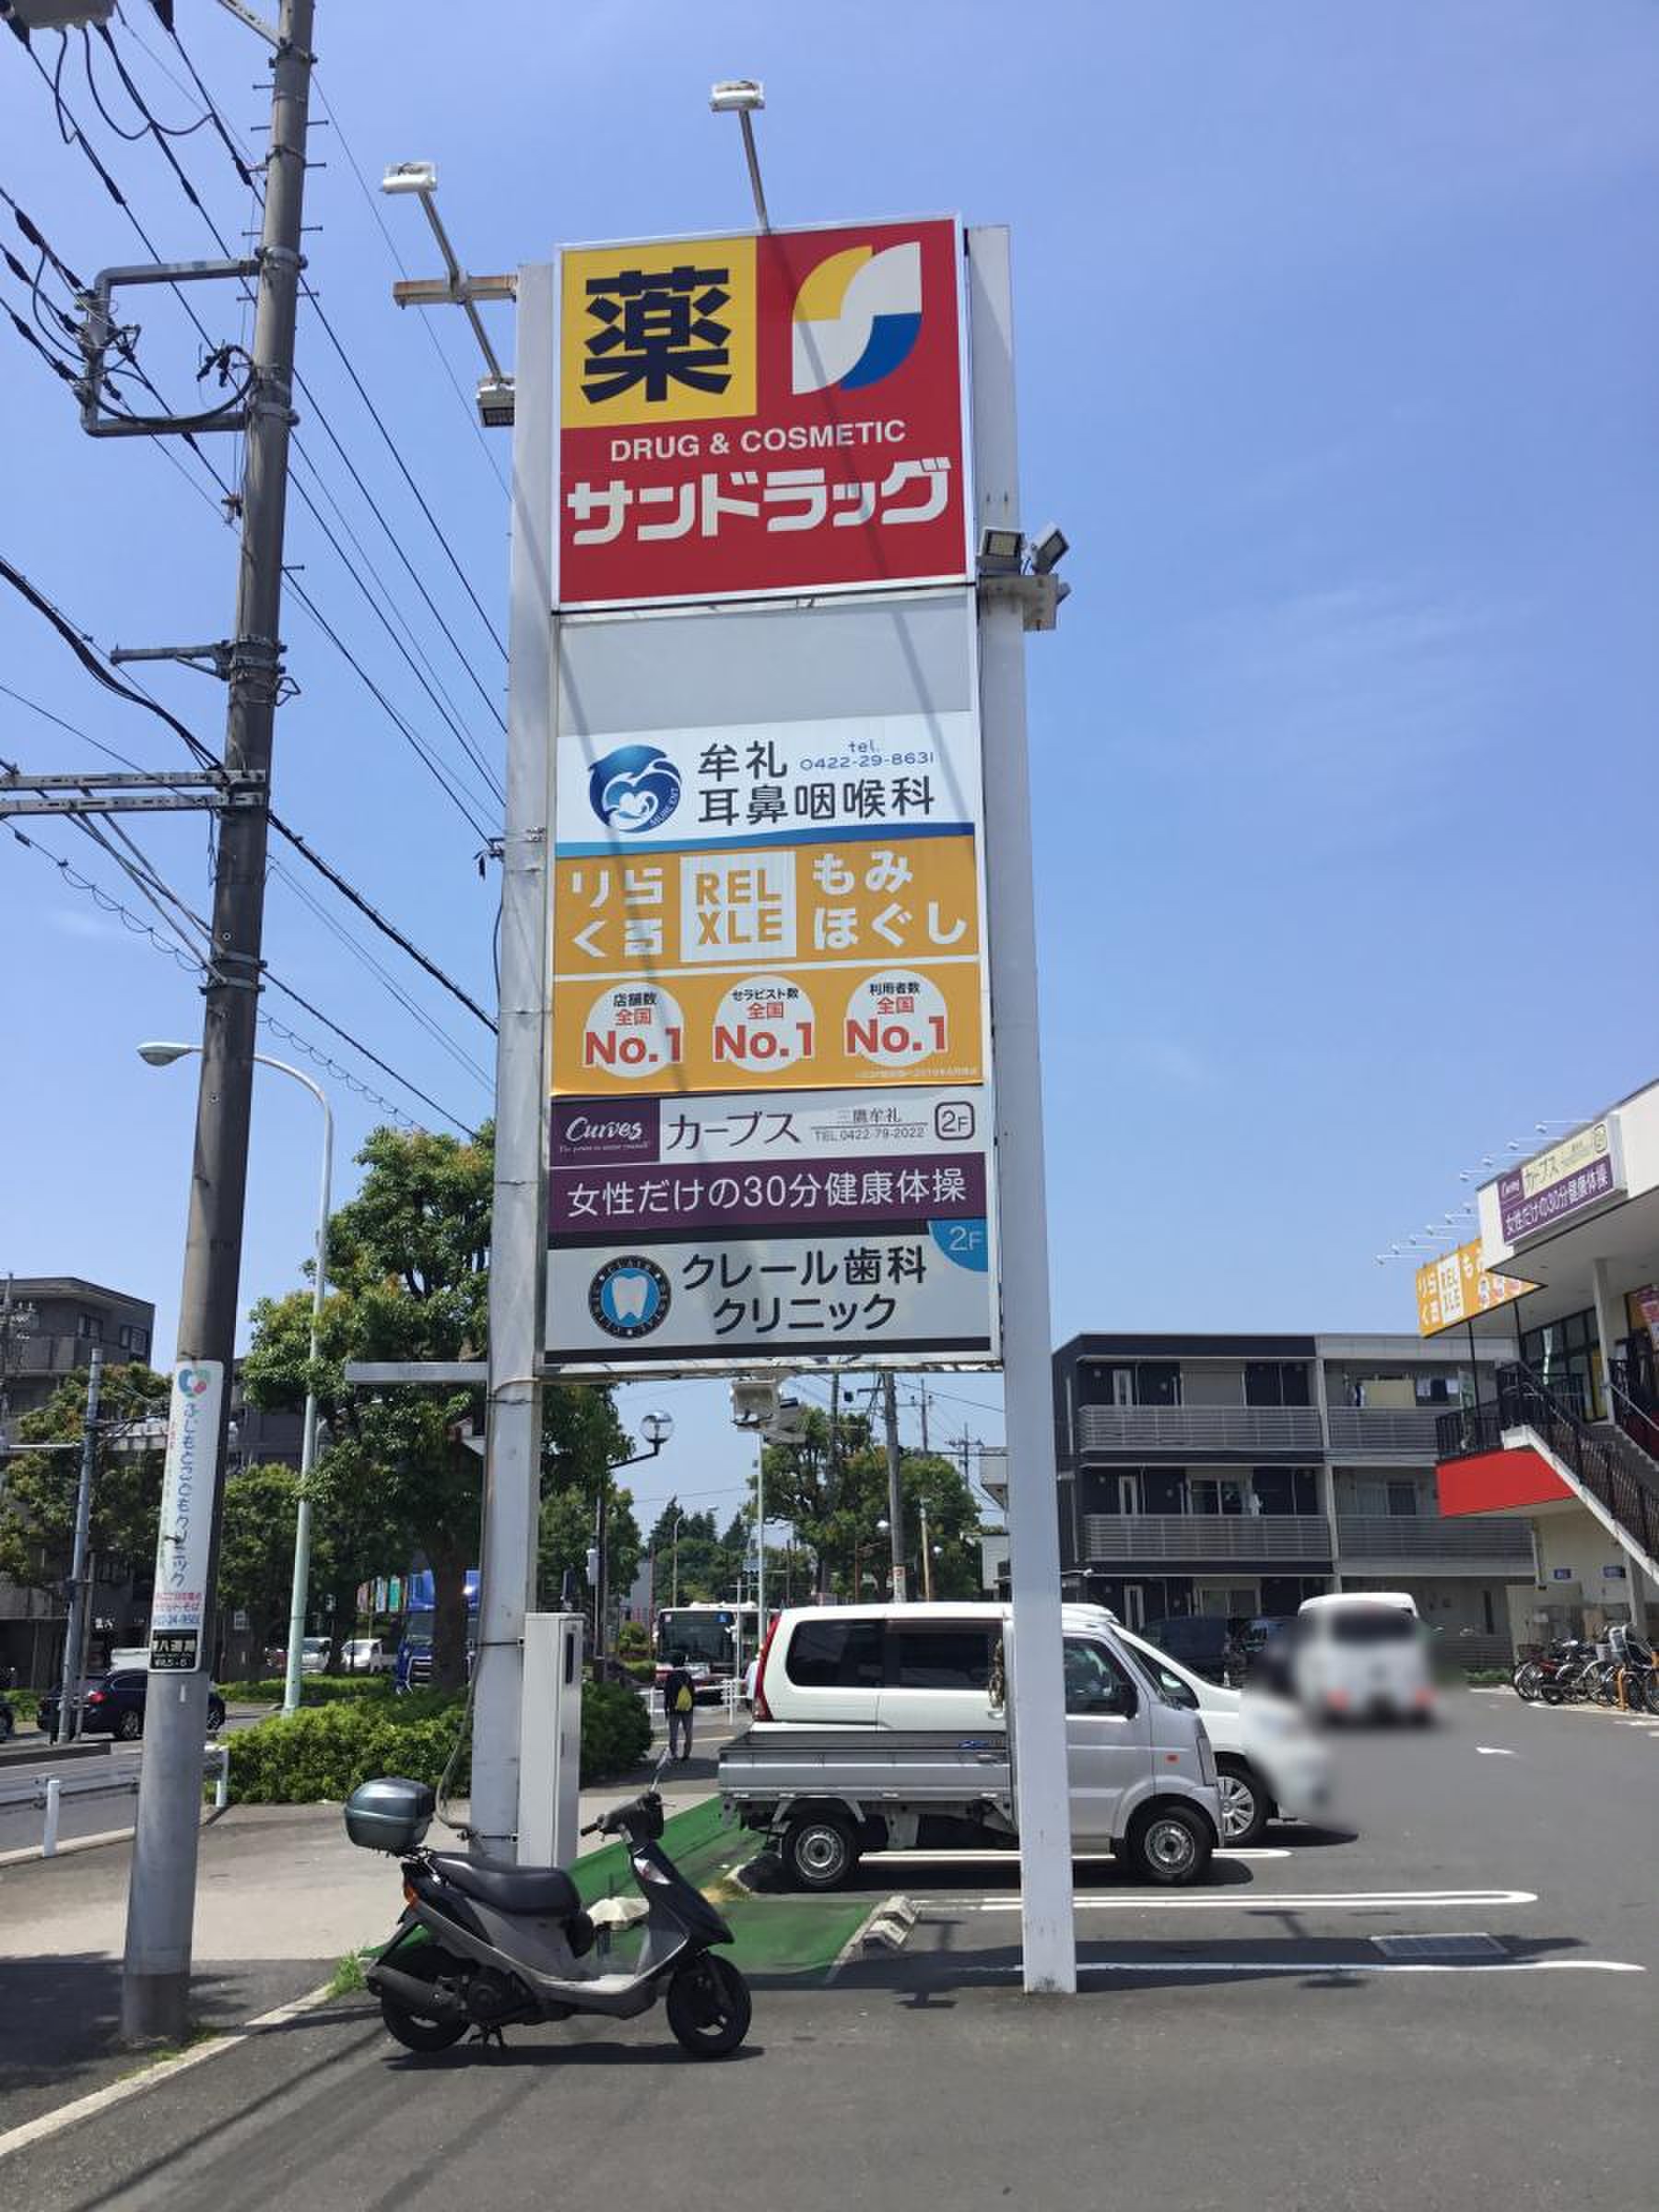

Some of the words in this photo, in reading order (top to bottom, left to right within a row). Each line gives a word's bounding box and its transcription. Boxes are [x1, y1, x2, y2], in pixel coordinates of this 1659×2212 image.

[581, 265, 732, 404] 薬
[611, 434, 700, 462] DRUG
[709, 431, 731, 454] &
[740, 419, 906, 453] COSMETIC
[567, 456, 951, 546] サンドラッグ
[698, 740, 788, 782] 牟礼
[799, 751, 935, 771] 0422-29-8631
[698, 775, 935, 826] 耳鼻咽喉科
[695, 868, 783, 907] REL
[813, 849, 913, 897] もみ
[697, 908, 783, 946] XLE
[813, 901, 968, 950] ほぐし
[615, 1008, 652, 1026] 全国
[747, 1002, 784, 1019] 全国
[877, 996, 915, 1015] 全国
[585, 1027, 682, 1065] No.1
[714, 1022, 813, 1060] No.1
[845, 1016, 946, 1054] No.1
[565, 1116, 643, 1142] Curves
[665, 1110, 801, 1151] カーブス
[941, 1109, 970, 1132] 2F
[567, 1167, 968, 1218] 女性だけの30分健康体操
[949, 1227, 983, 1252] 2F
[682, 1245, 927, 1291] クレール歯科
[712, 1294, 897, 1336] クリニック
